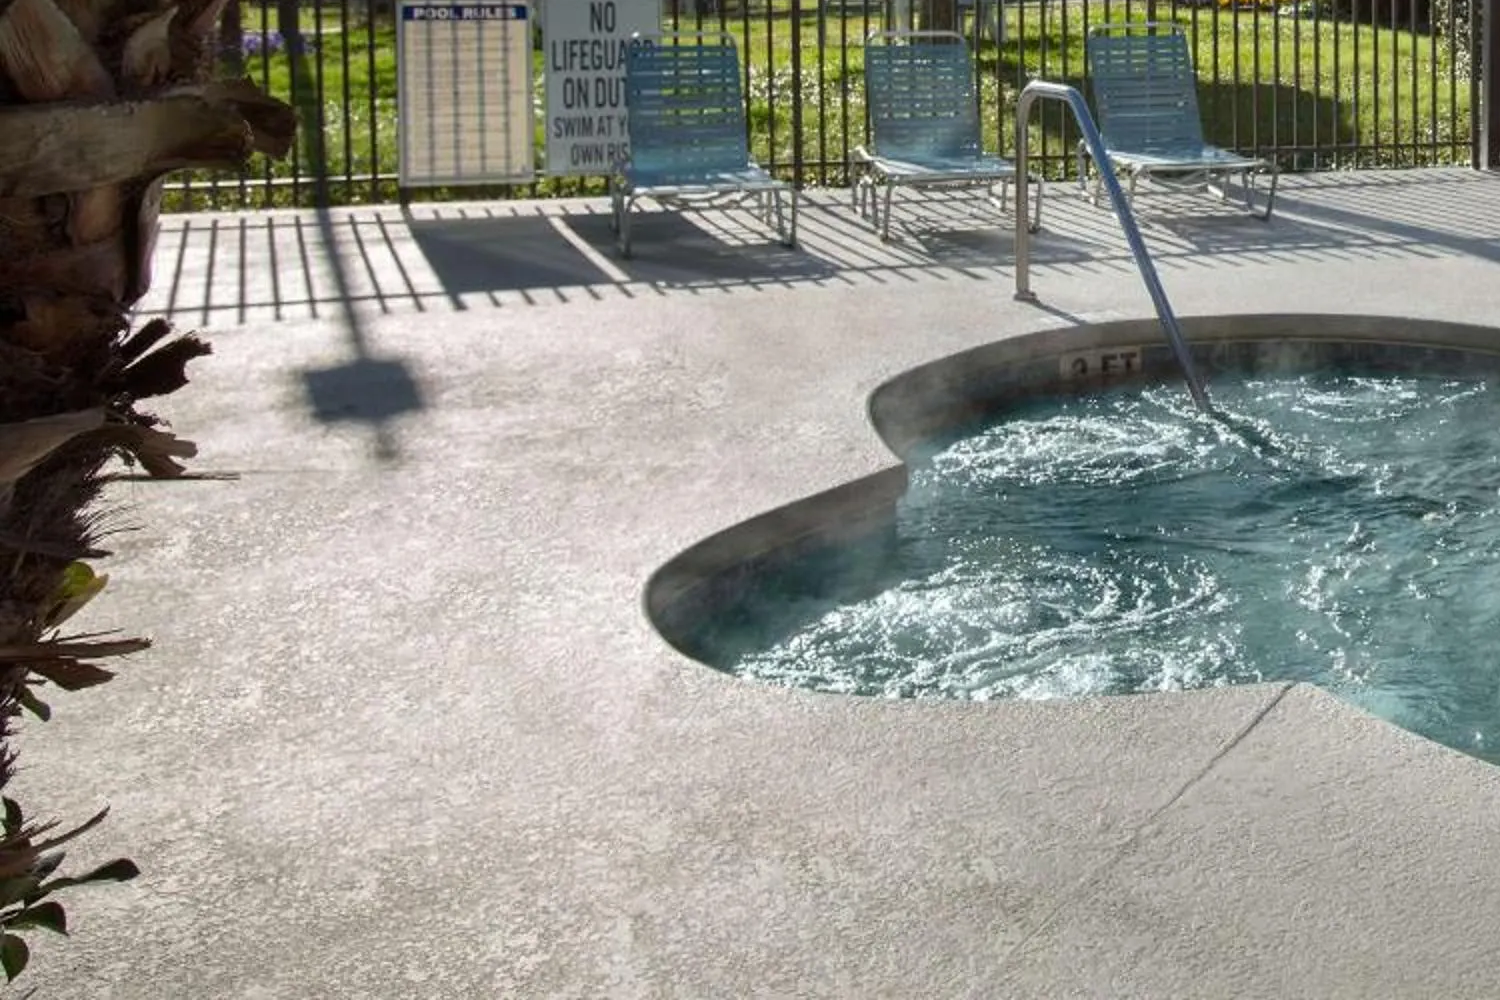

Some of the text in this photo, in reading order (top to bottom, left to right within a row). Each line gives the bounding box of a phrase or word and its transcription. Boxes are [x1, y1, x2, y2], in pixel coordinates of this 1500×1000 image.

[413, 7, 456, 19] POOL
[590, 1, 616, 32] NO
[563, 78, 589, 109] ON
[553, 116, 593, 138] SWIM
[597, 116, 614, 137] AT
[570, 143, 630, 166] OWN RIS
[1101, 352, 1138, 375] FT
